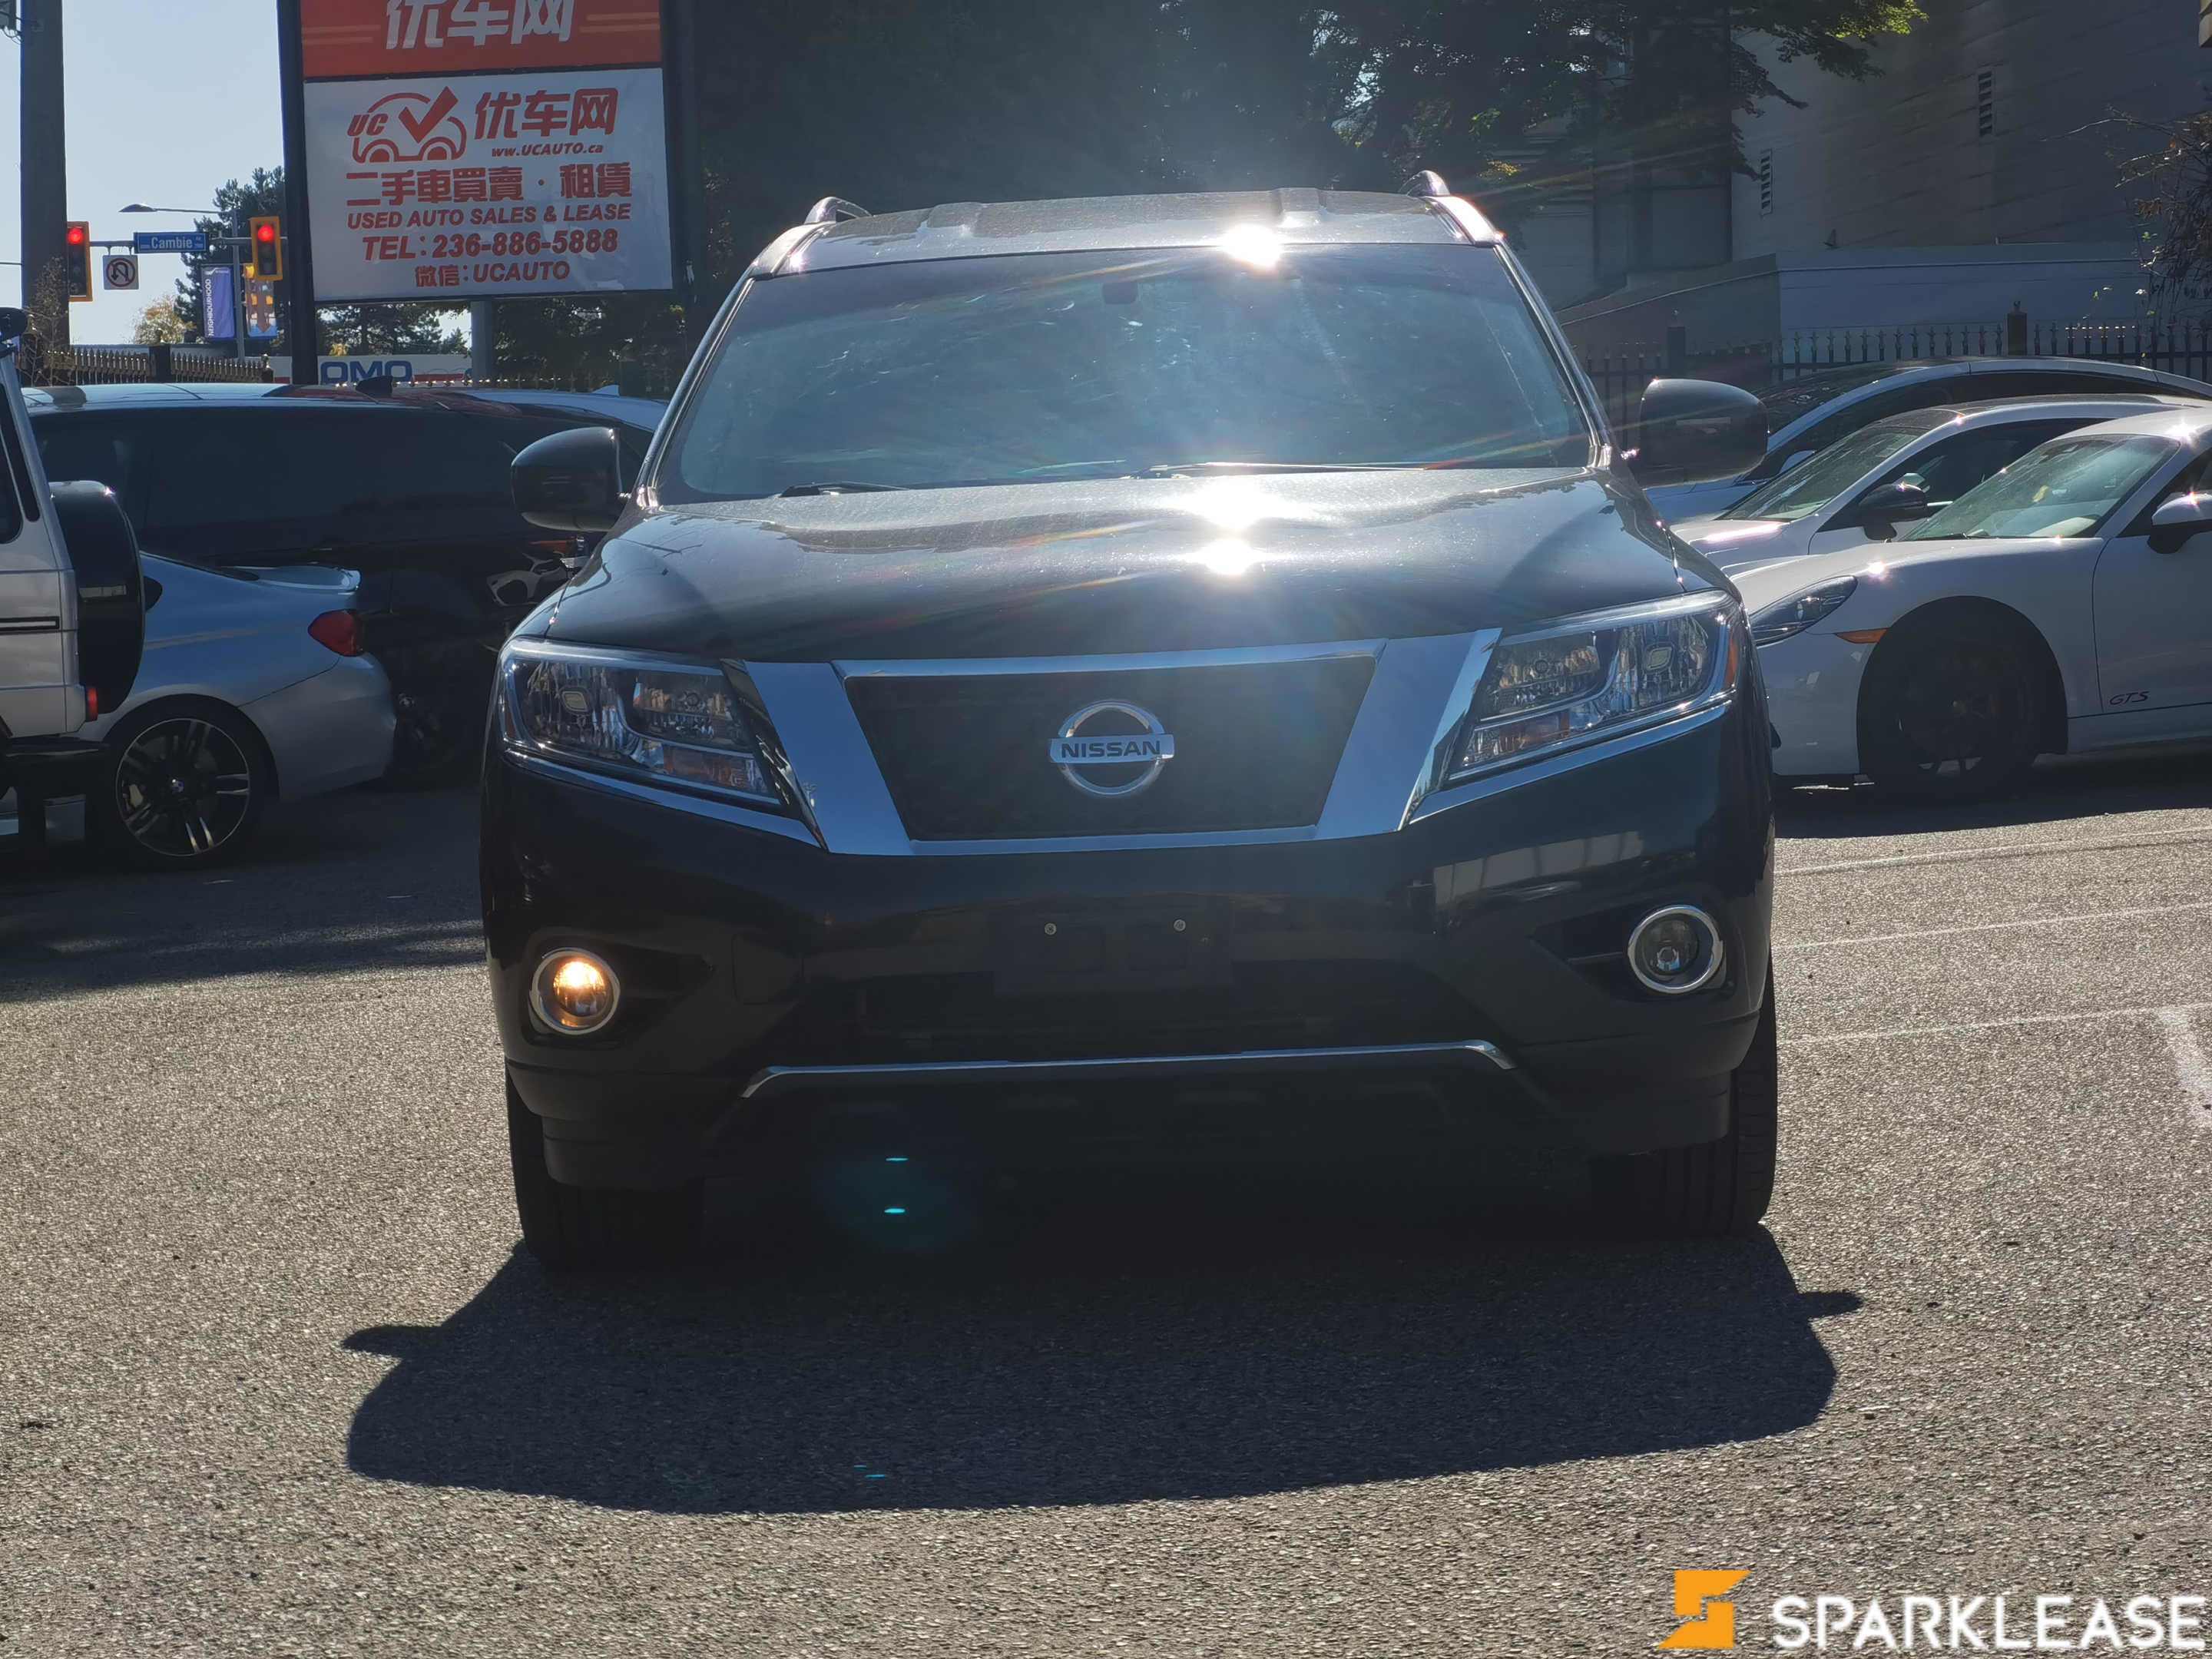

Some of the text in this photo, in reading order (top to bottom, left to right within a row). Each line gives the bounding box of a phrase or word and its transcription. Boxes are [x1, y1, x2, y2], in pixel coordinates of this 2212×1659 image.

[386, 0, 575, 49] 优车网
[347, 114, 389, 137] UC
[474, 88, 618, 140] 优车网
[346, 167, 524, 207] 二手車買賣
[347, 203, 631, 230] USED AUTO SALES & LEASE
[151, 236, 193, 250] Cambie
[2109, 690, 2150, 706] GTS
[1061, 740, 1161, 759] NISSAN
